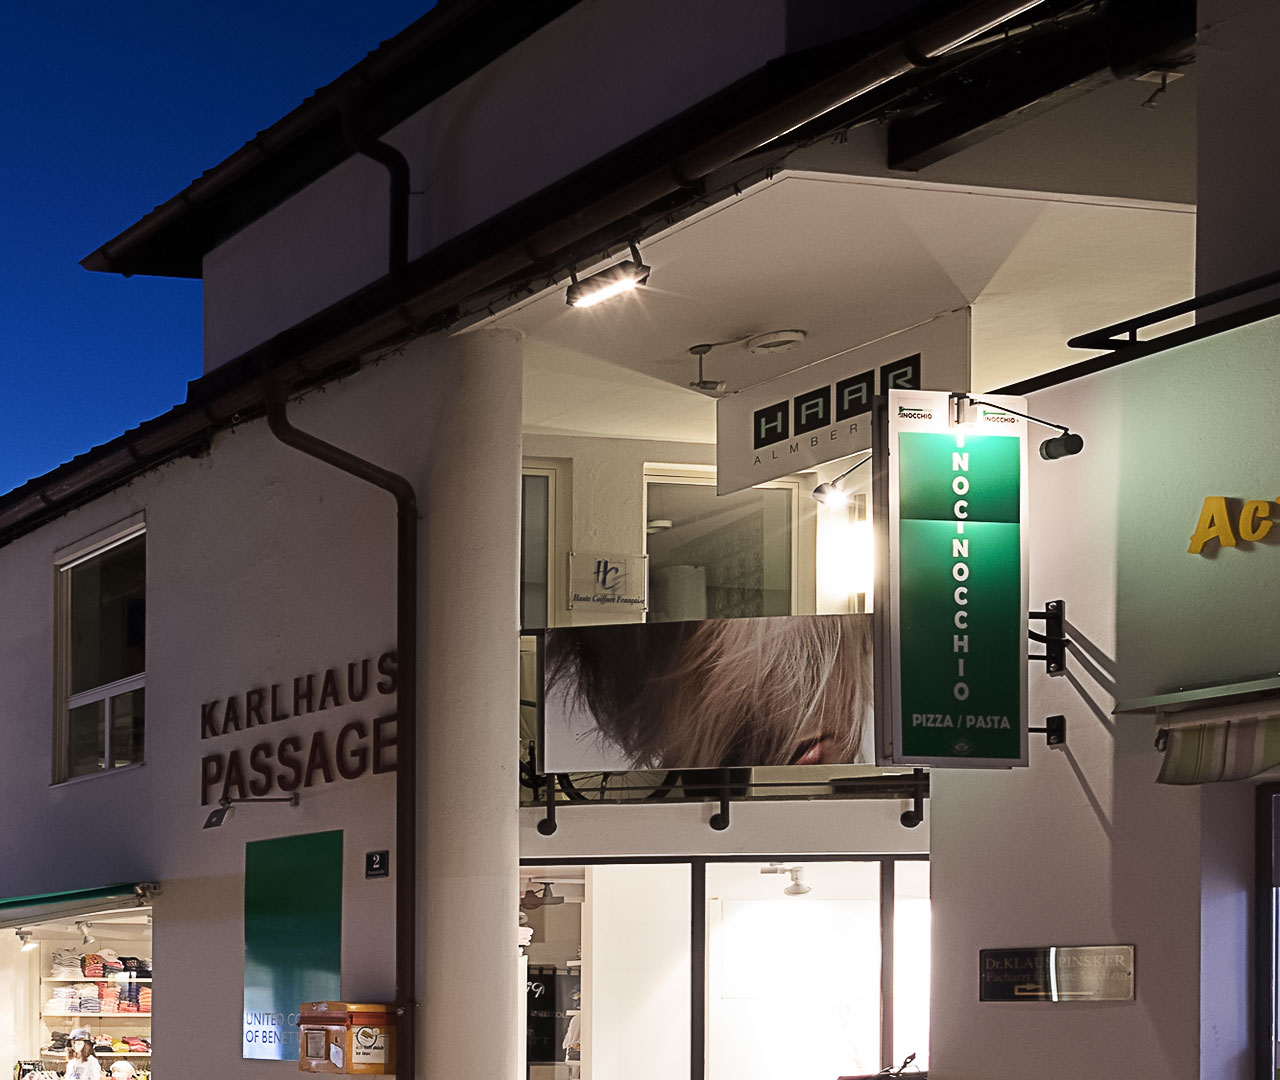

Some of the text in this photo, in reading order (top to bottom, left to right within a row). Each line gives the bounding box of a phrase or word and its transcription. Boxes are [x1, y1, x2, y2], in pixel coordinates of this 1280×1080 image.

[760, 366, 913, 439] HAAR
[753, 423, 873, 466] ALMBER
[200, 651, 398, 740] KARLHAUS
[912, 713, 954, 728] PIZZA
[966, 715, 1011, 729] PASTA
[201, 712, 398, 807] PASSAGE
[373, 854, 380, 869] 2
[1059, 954, 1127, 968] PINSKER
[247, 1013, 285, 1025] UNITED
[246, 1030, 259, 1043] OF
